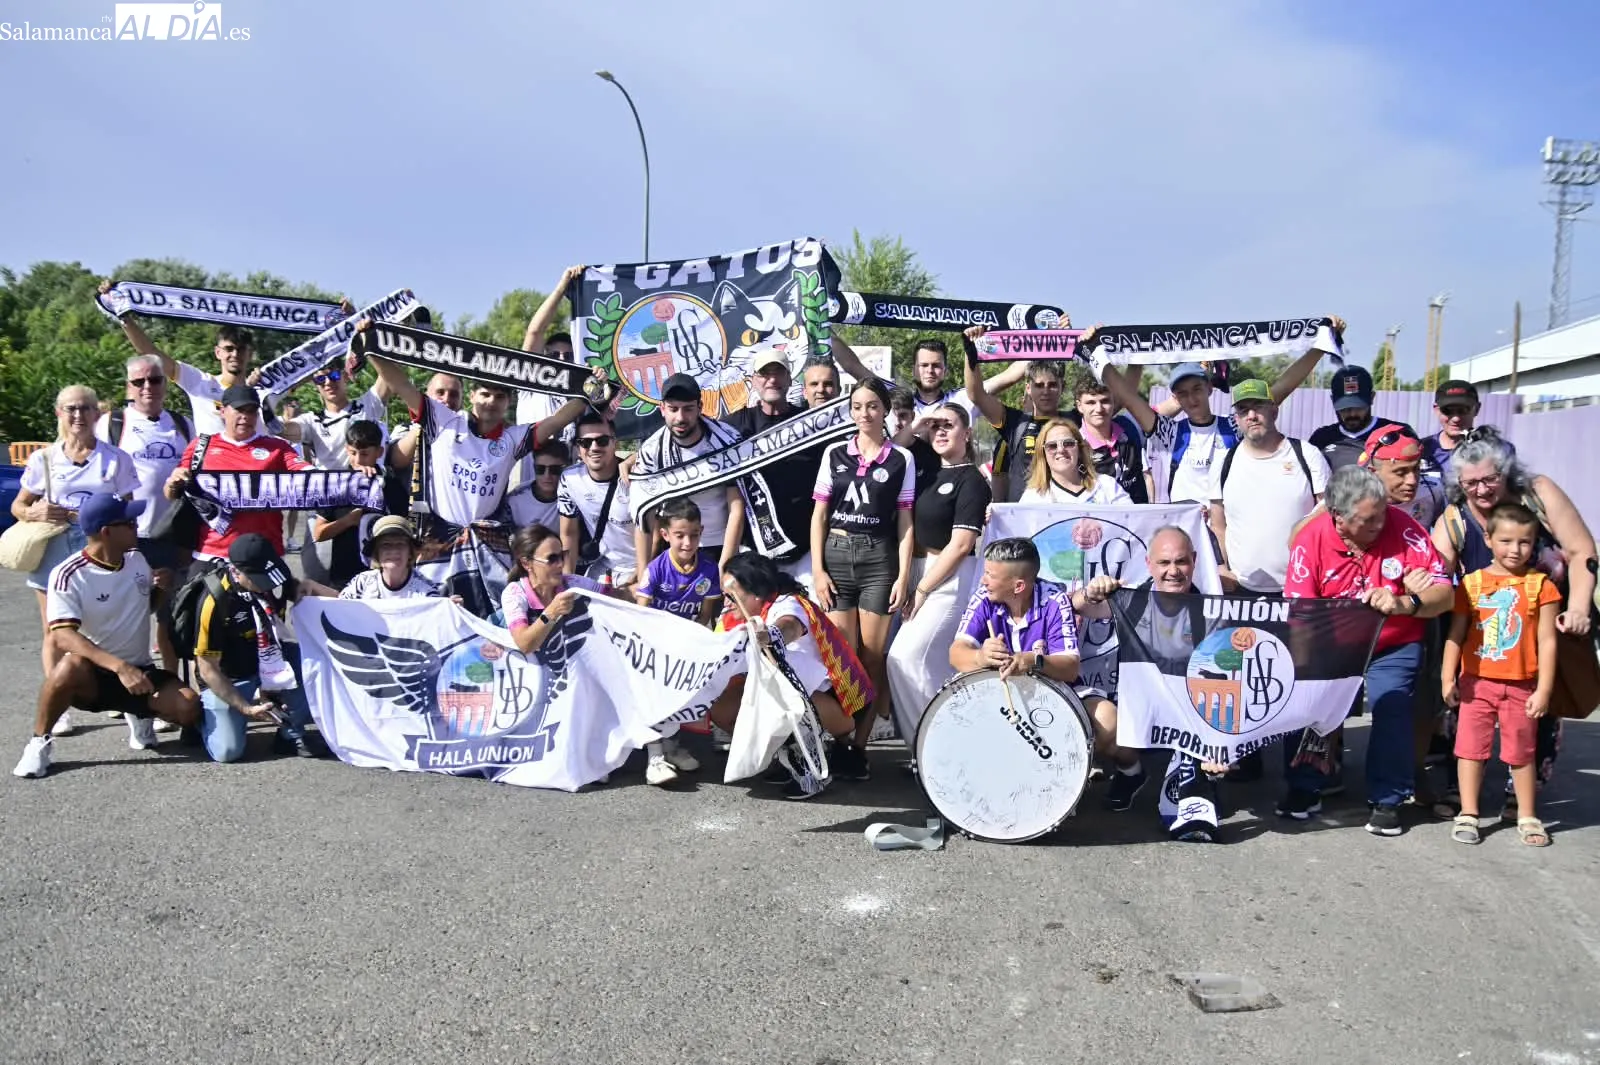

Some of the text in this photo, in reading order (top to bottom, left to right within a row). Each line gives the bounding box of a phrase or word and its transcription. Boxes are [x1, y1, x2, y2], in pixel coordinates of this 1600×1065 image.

[127, 289, 320, 325] U.D. SALAMANCA
[874, 303, 1000, 327] SALAMANCA
[1100, 318, 1323, 353] SALAMANCA UDS
[257, 351, 307, 390] OMOS
[666, 406, 845, 487] U.D. SALAMANCA
[452, 463, 478, 482] EXPO
[196, 472, 385, 509] SALAMANCA
[1203, 596, 1290, 622] UNIÓN
[602, 625, 656, 680] EÑA
[428, 744, 535, 767] HALA UNION
